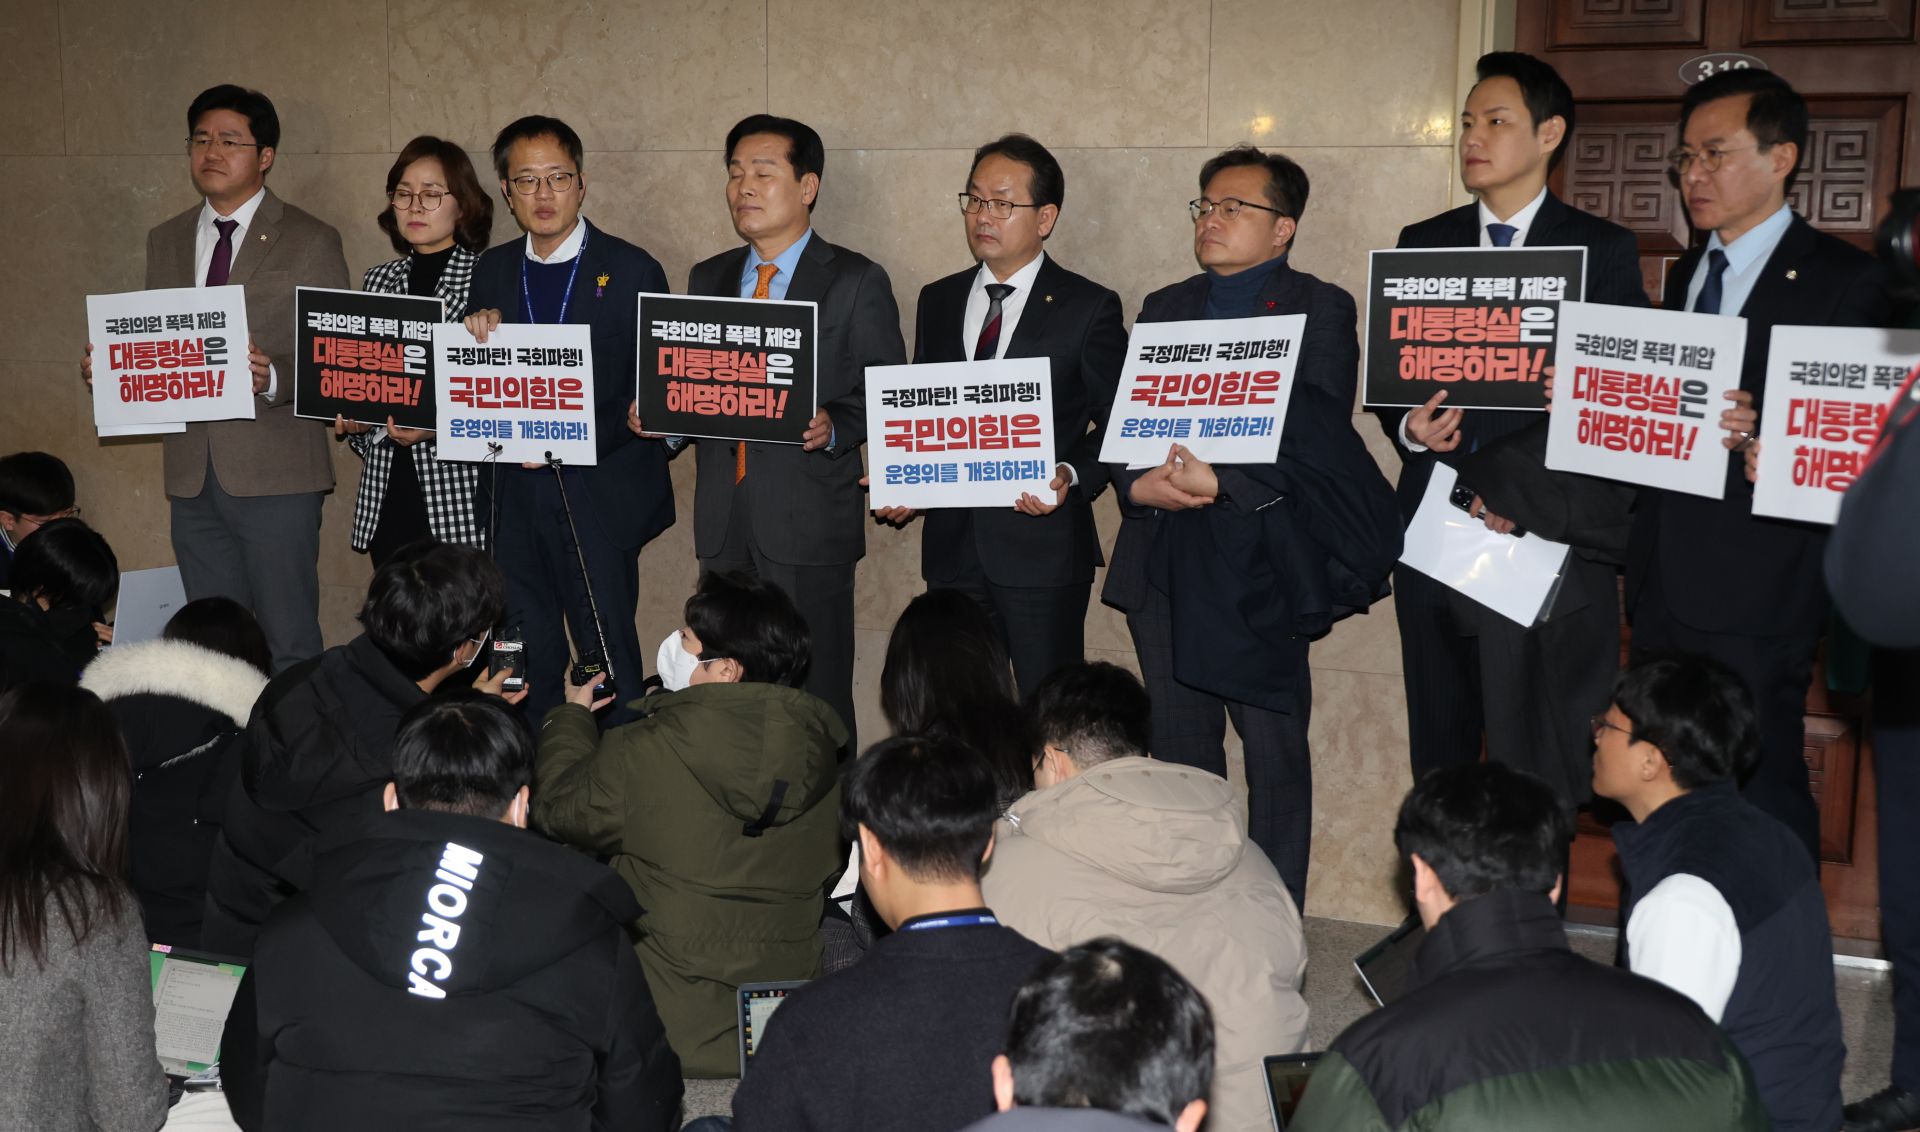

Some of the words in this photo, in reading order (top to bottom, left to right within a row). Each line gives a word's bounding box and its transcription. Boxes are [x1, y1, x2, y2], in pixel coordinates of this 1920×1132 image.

[1383, 276, 1467, 301] 국회의원
[1471, 277, 1516, 300] 폭력
[1519, 276, 1567, 300] 제압
[105, 315, 163, 335] 국회의원
[165, 313, 194, 331] 폭력
[196, 311, 226, 330] 제압
[307, 311, 366, 336] 국회의원
[369, 318, 399, 338] 폭력
[401, 320, 433, 342] 제압
[651, 320, 721, 344] 국회의원
[725, 324, 761, 346] 폭력
[764, 326, 802, 350] 제압
[1389, 306, 1555, 343] 대통령실은
[109, 336, 229, 371] 대통령실은
[313, 336, 426, 375] 대통령실은
[446, 346, 512, 367] 국정파탄!
[516, 347, 583, 367] 국회파행!
[657, 346, 794, 385] 대통령실은
[1139, 344, 1212, 364] 국정파탄!
[1215, 339, 1291, 361] 국회파행!
[1399, 345, 1547, 382] 해명하라!
[1574, 333, 1638, 362] 국회의원
[1641, 339, 1675, 366] 폭력
[1678, 345, 1715, 371] 제압
[119, 370, 225, 403] 해명하라!
[320, 368, 422, 407] 해명하라!
[1131, 370, 1281, 407] 국민의힘은
[1790, 360, 1867, 389] 국회의원
[449, 376, 584, 411] 국민의힘은
[666, 381, 788, 419] 해명하라!
[881, 386, 957, 408] 국정파탄!
[963, 382, 1041, 405] 국회파행!
[1572, 366, 1708, 419] 대통령실은
[449, 418, 513, 439] 운영위를
[517, 420, 588, 441] 개회하라!
[884, 413, 1042, 452] 국민의힘은
[1120, 416, 1192, 439] 운영위를
[1198, 416, 1274, 438] 개회하라!
[1577, 408, 1699, 461] 해명하라!
[885, 463, 958, 485] 운영위를
[963, 460, 1046, 482] 개회하라!
[407, 841, 484, 999] MIORCA
